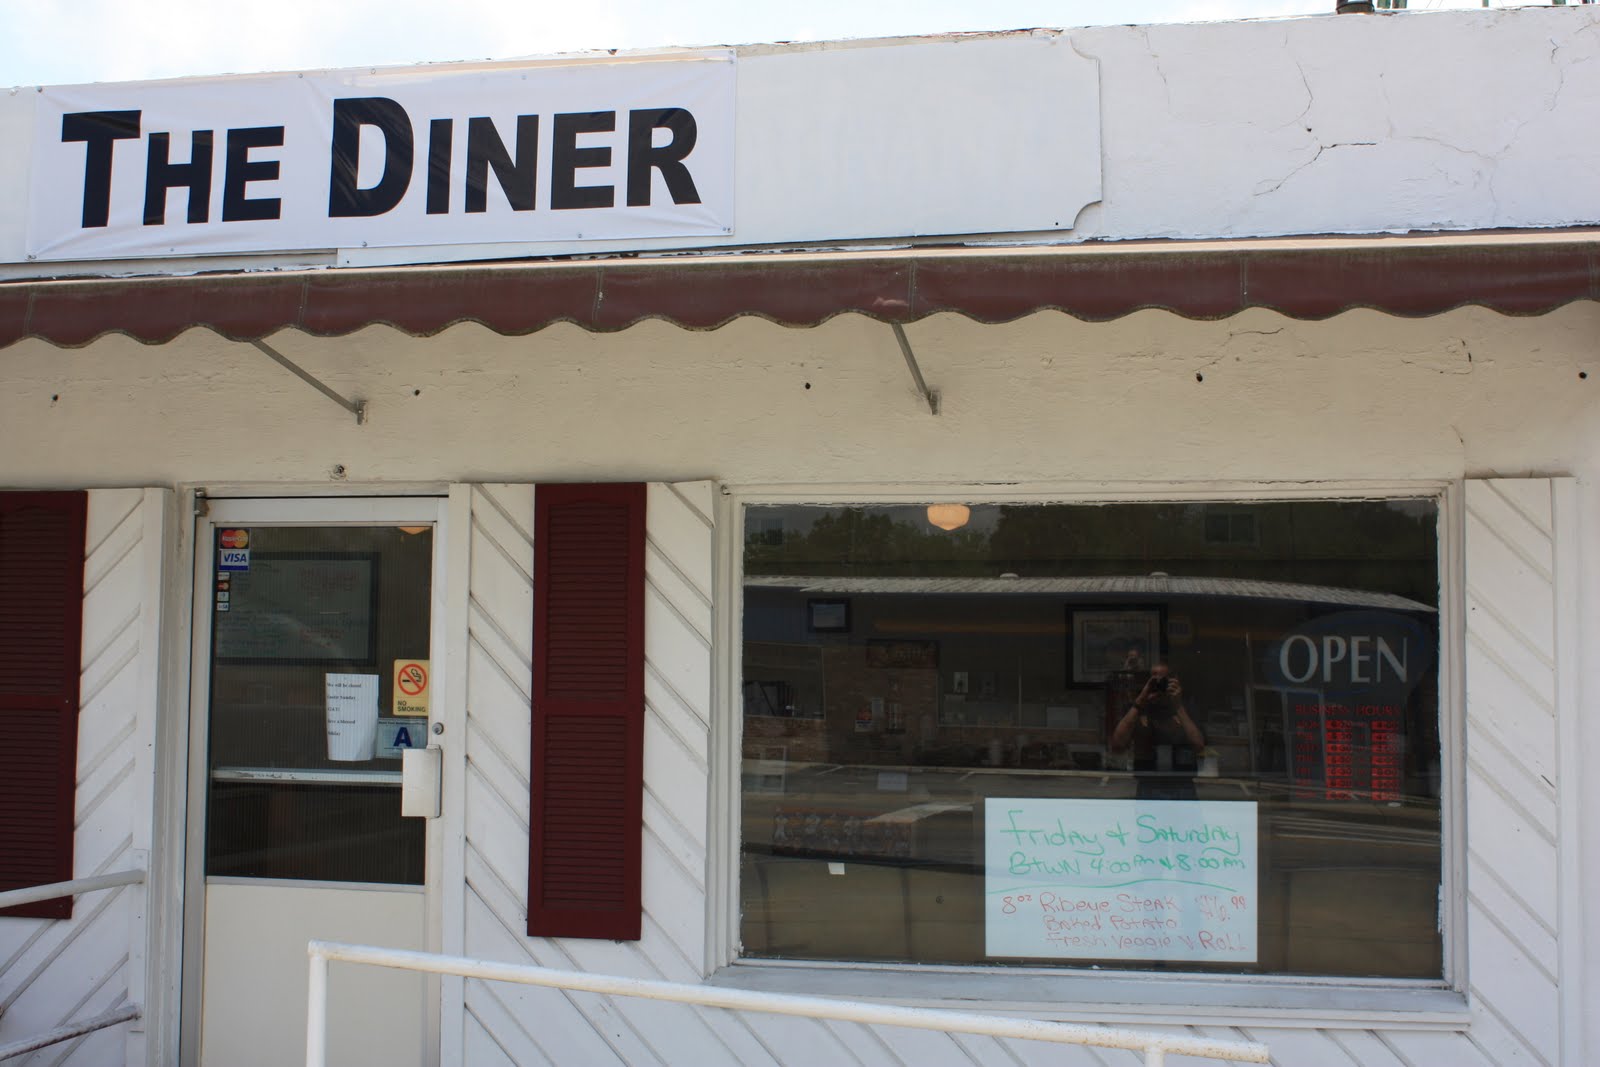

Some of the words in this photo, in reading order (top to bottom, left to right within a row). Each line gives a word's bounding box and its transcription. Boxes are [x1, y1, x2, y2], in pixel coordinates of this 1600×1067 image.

[61, 109, 285, 230] THE
[328, 96, 702, 219] DINER
[224, 553, 247, 563] VISA
[1279, 634, 1408, 684] OPEN
[393, 726, 413, 747] A
[1000, 809, 1105, 856] Friday
[1136, 814, 1241, 857] Saturday
[1039, 891, 1111, 914] Ribeye
